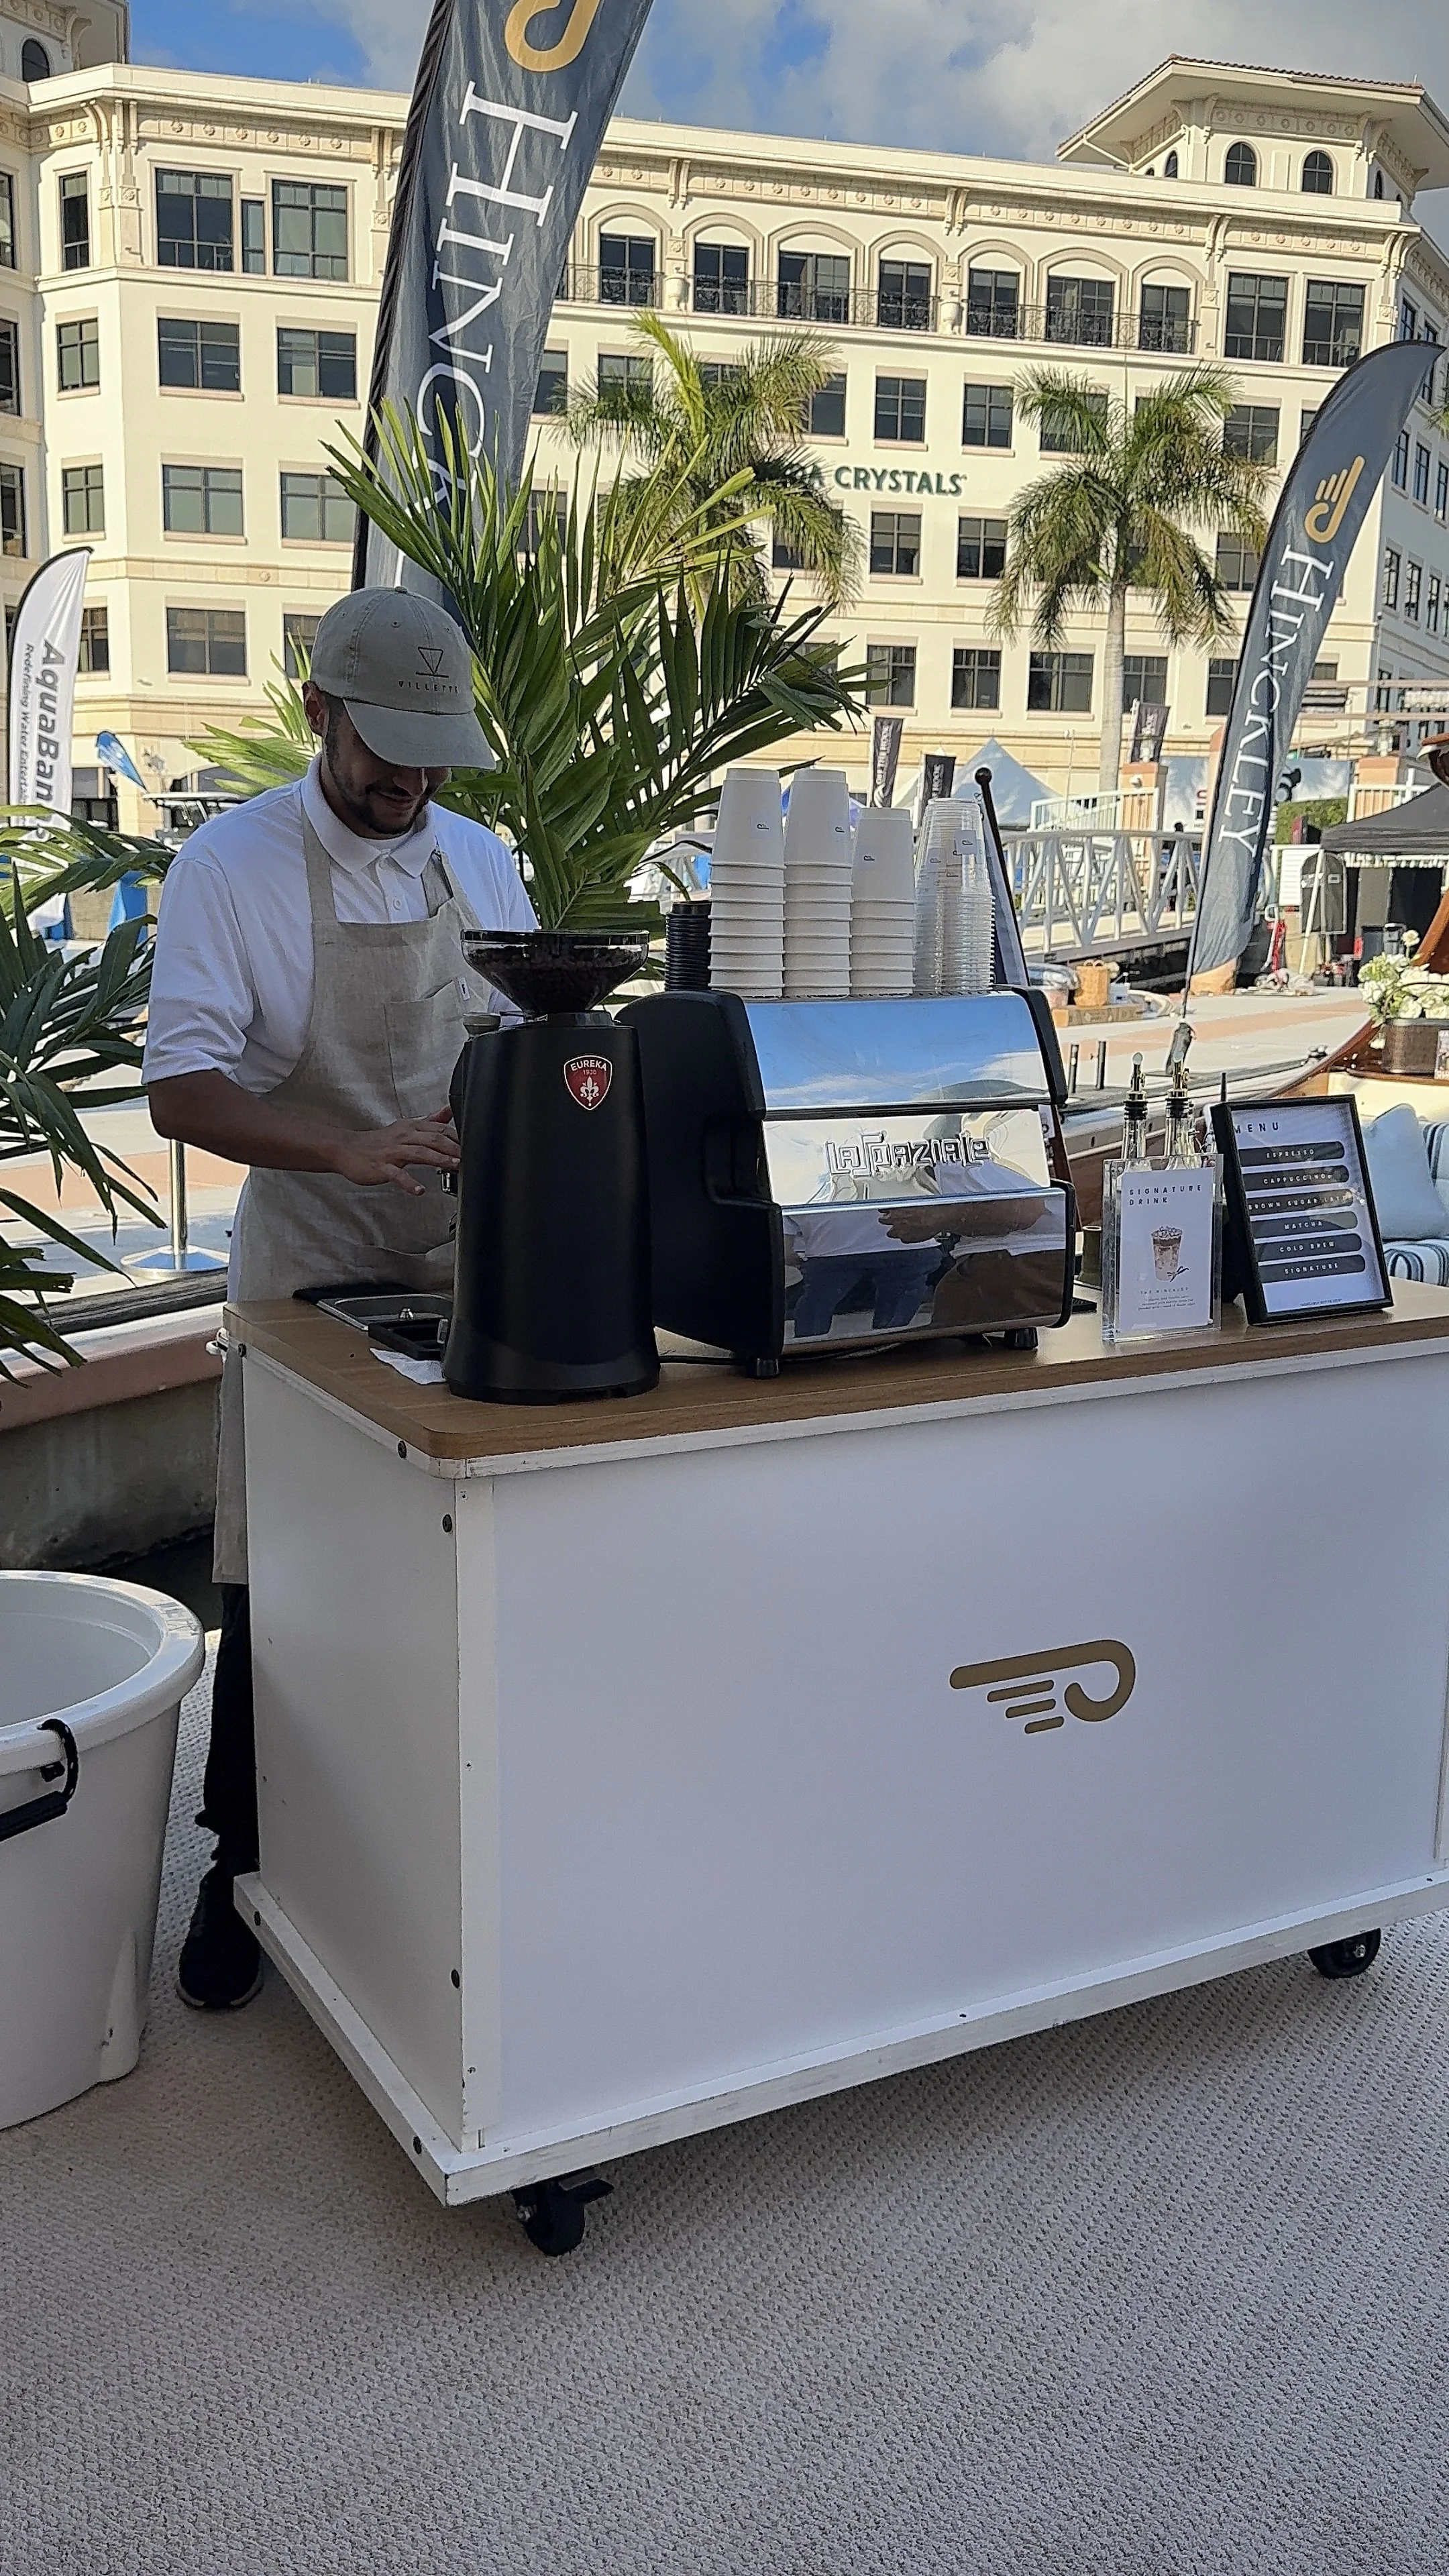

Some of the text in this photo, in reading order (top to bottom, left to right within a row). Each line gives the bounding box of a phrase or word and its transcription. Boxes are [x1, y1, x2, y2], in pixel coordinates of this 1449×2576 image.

[835, 466, 963, 496] CRYSTALS
[20, 642, 35, 707] Redefining
[398, 680, 458, 694] VILLETTE
[1218, 544, 1334, 858] HINCKLEY
[20, 711, 30, 746] Water
[570, 1060, 606, 1071] EUREKA
[1234, 1122, 1279, 1134] MENU
[1266, 1148, 1315, 1159] ESPRESSO
[1263, 1173, 1326, 1185] CAPPUCCINO
[1130, 1185, 1201, 1195] SIGNATURE
[1129, 1197, 1168, 1205] DRINK
[1248, 1201, 1281, 1210] BROWN
[1287, 1197, 1318, 1207] SUGAR
[1283, 1220, 1323, 1230] MATCHA
[1279, 1241, 1335, 1253] COLD BREW
[1284, 1262, 1339, 1275] SIGNATURE
